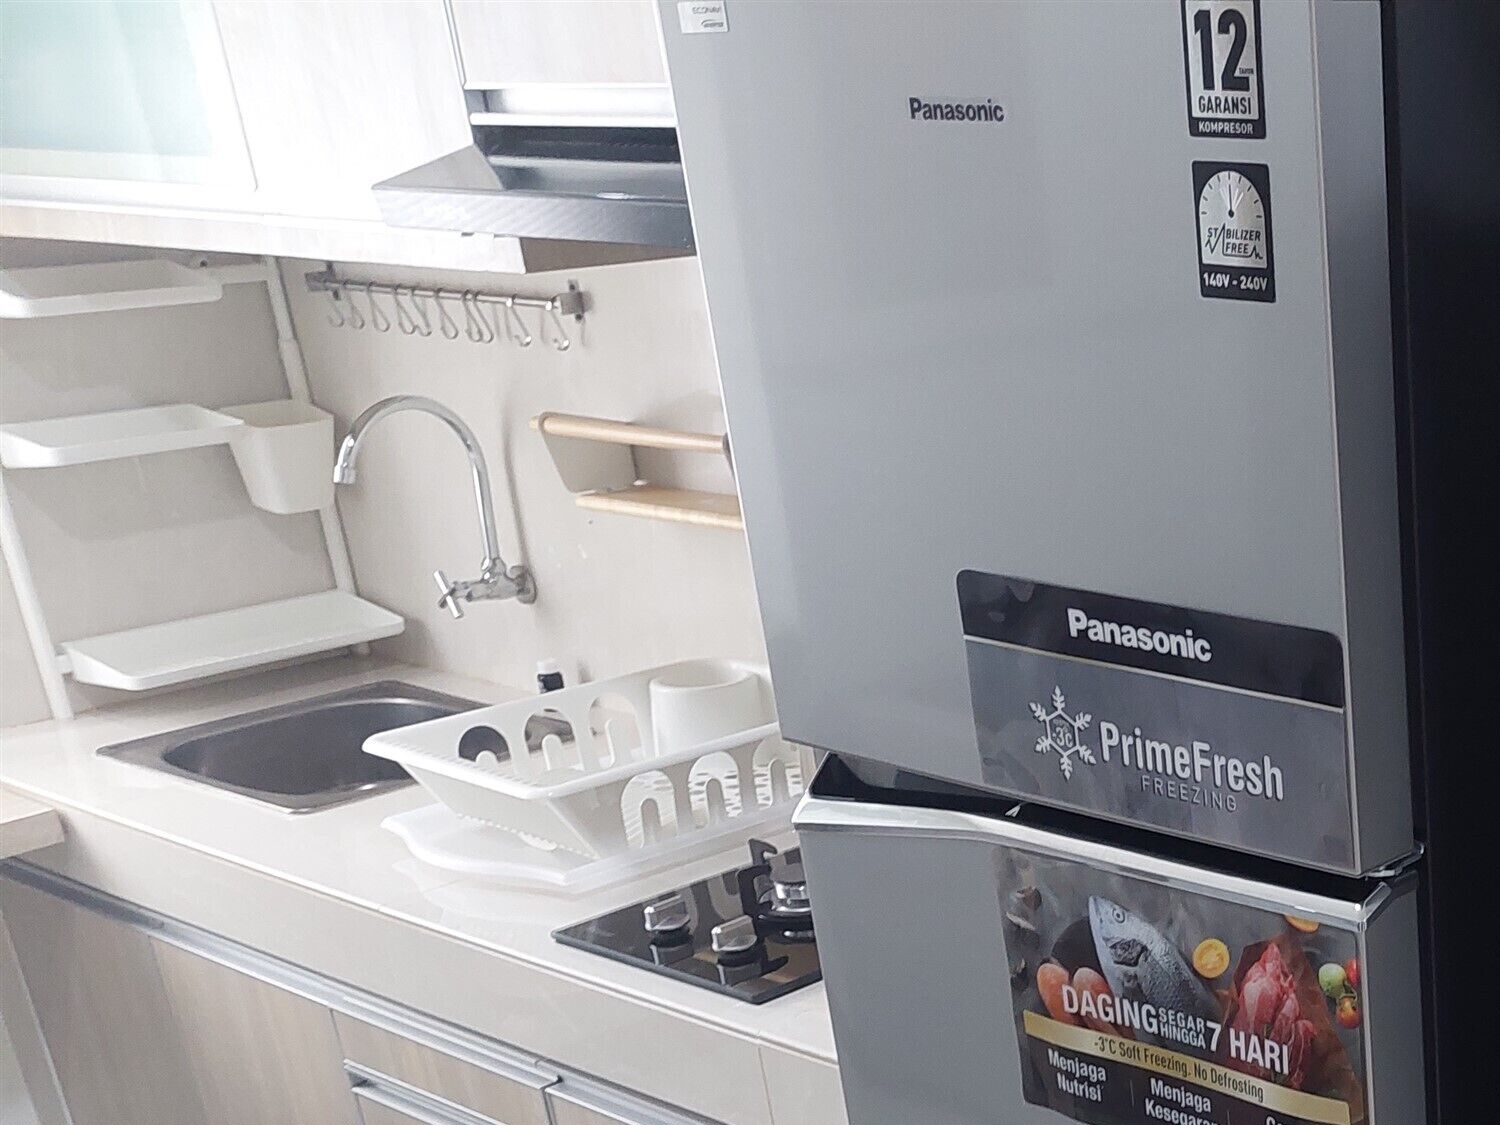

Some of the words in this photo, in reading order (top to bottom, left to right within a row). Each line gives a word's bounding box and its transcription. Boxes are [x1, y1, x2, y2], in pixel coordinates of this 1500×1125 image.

[1194, 8, 1250, 91] 12
[908, 97, 1004, 122] Panasonic
[1198, 95, 1251, 115] GARANSI
[1198, 121, 1254, 134] KOMPRESOR
[1225, 242, 1249, 253] FREE
[1203, 272, 1230, 288] 140V
[1240, 275, 1267, 291] 240V
[1067, 608, 1212, 662] Panasonic
[1100, 721, 1284, 801] PrimeFresh
[1141, 775, 1237, 812] FREEZING
[1061, 984, 1159, 1035] DAGING
[1158, 1007, 1204, 1033] SEGAR
[1160, 1022, 1206, 1049] HINGGA
[1207, 1020, 1221, 1051] 7
[1229, 1028, 1290, 1075] HARI
[1048, 1049, 1106, 1083] Menjaga
[1118, 1043, 1141, 1061] Soft
[1193, 1063, 1207, 1079] No
[1210, 1067, 1264, 1102] Defrosting
[1057, 1073, 1102, 1102] Nutrisi
[1150, 1078, 1211, 1112] Menjaga
